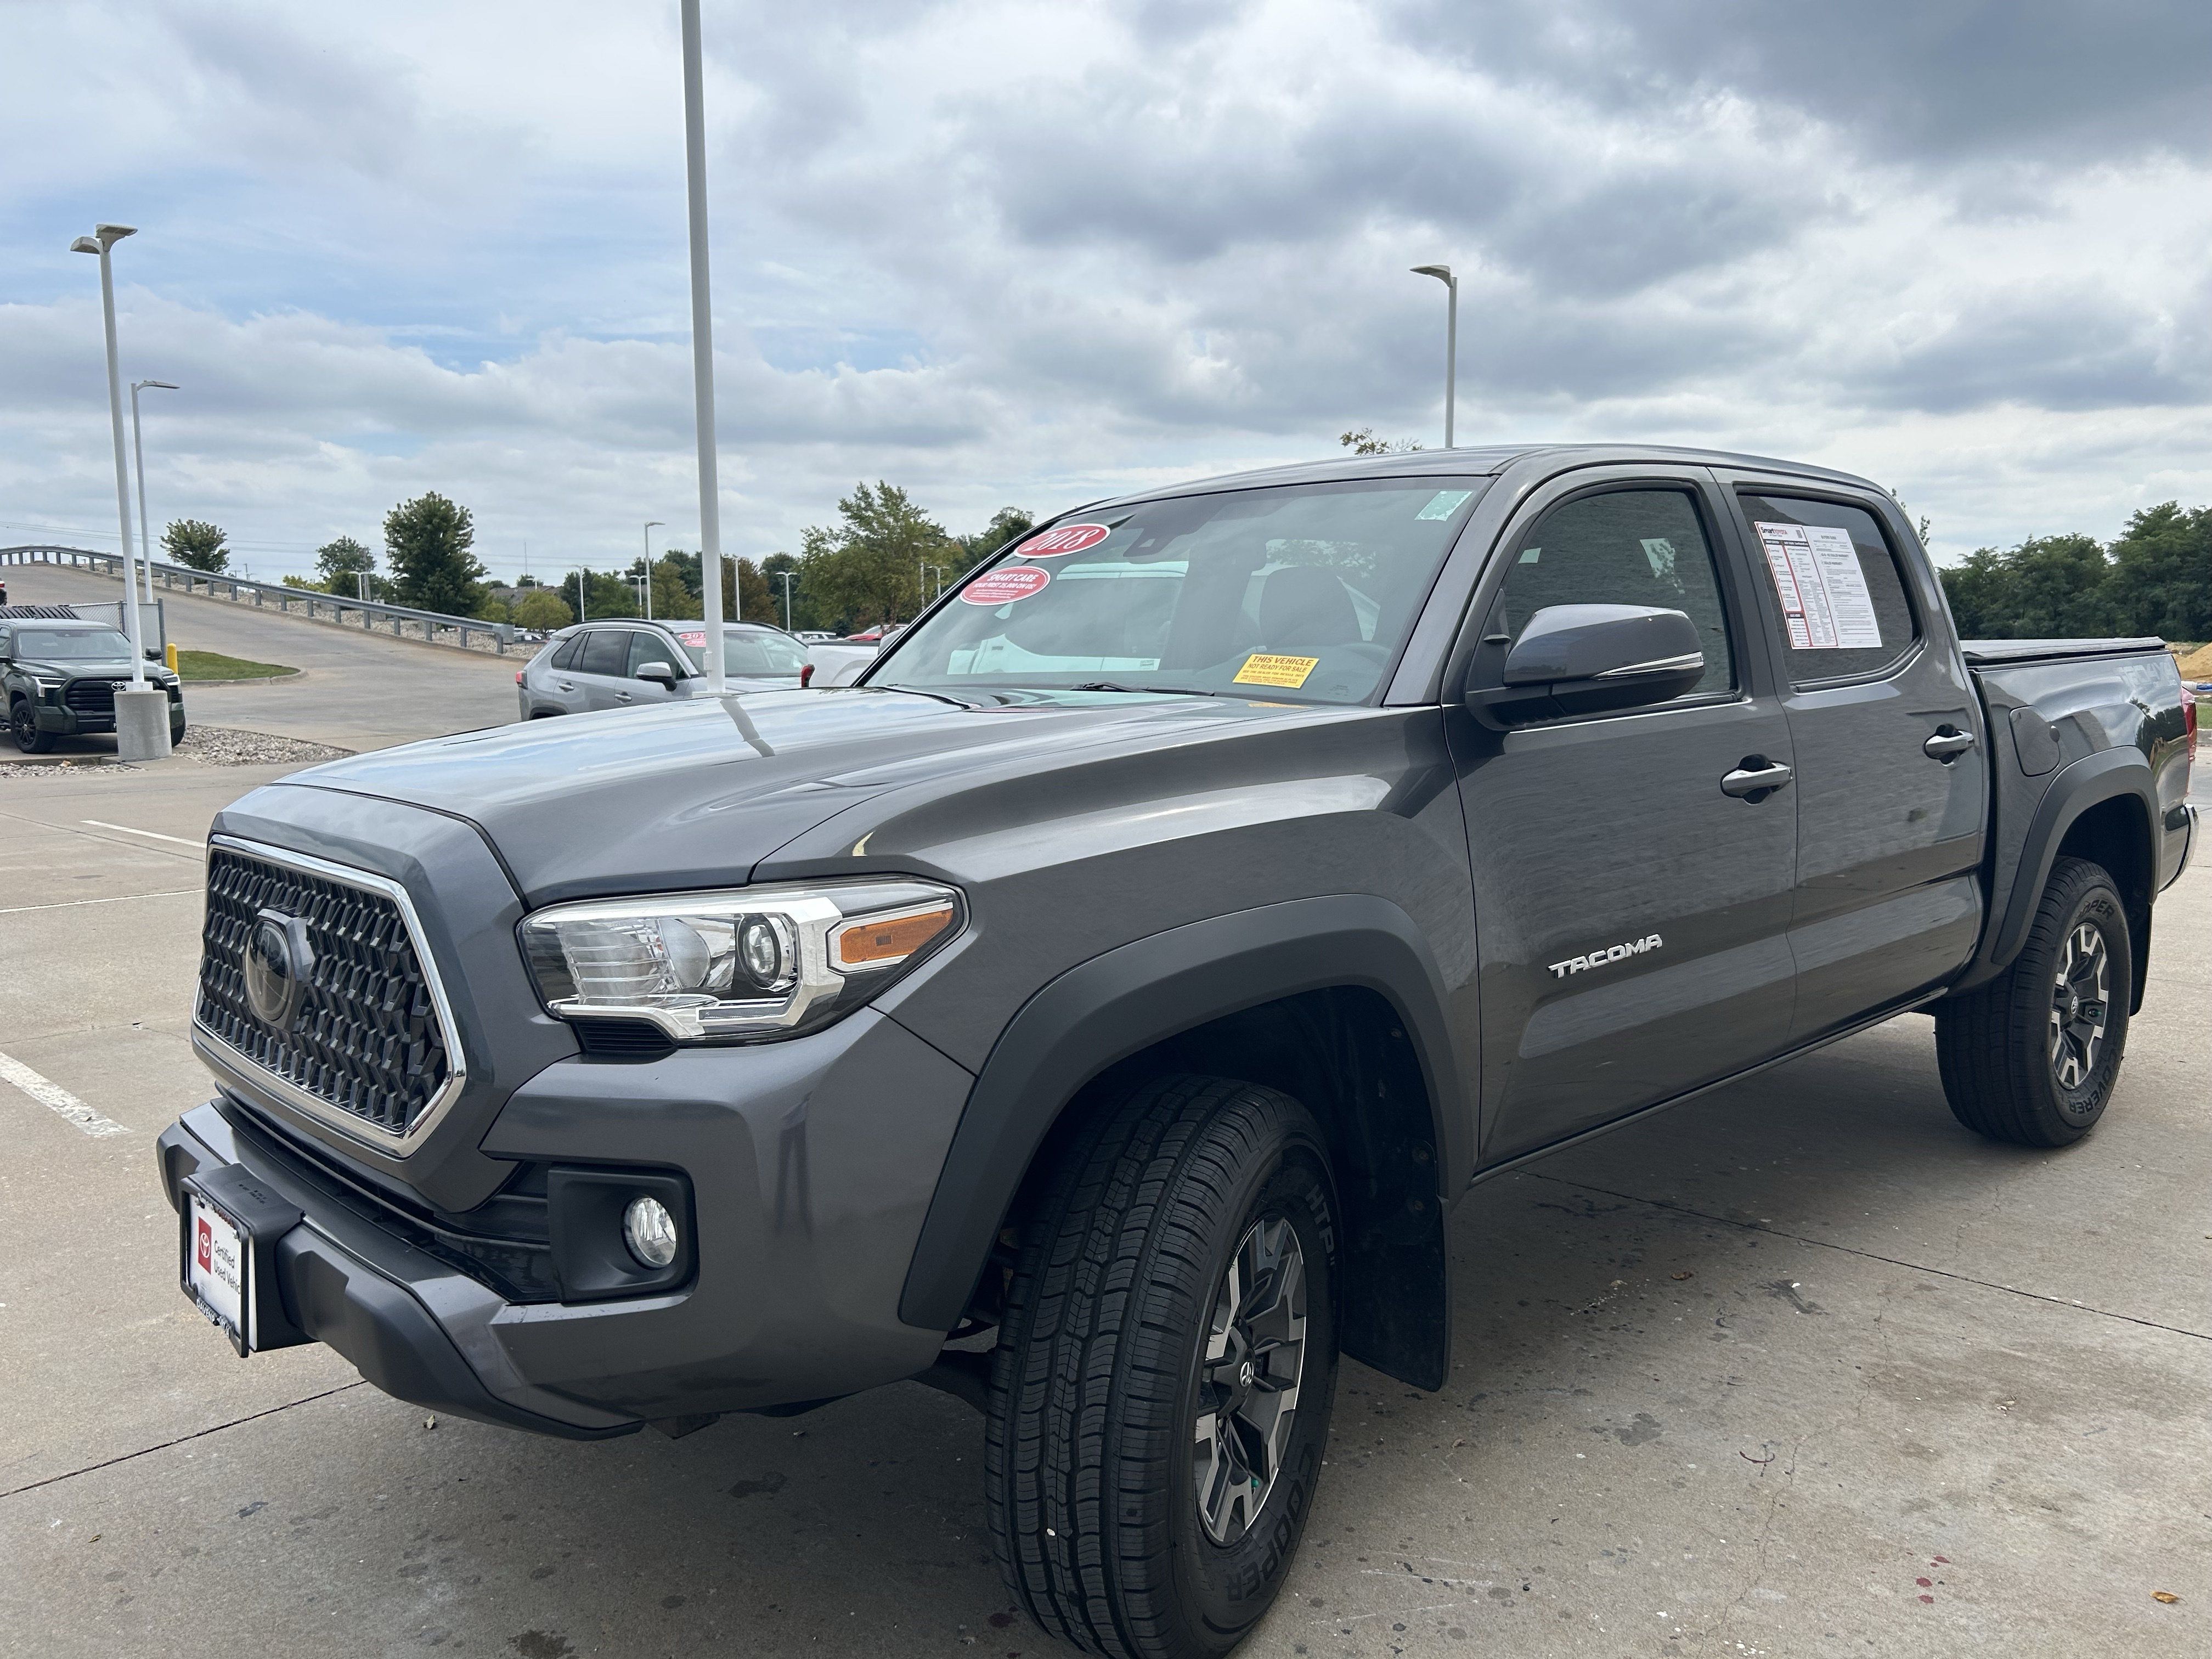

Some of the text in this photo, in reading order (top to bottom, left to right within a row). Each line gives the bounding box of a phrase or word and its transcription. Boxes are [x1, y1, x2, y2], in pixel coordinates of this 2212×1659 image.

[1023, 528, 1101, 551] 2018
[1275, 657, 1314, 666] VEHICLE
[1548, 934, 1663, 979] TACOMA
[214, 1239, 235, 1268] Certified
[213, 1259, 241, 1295] Used Vehic
